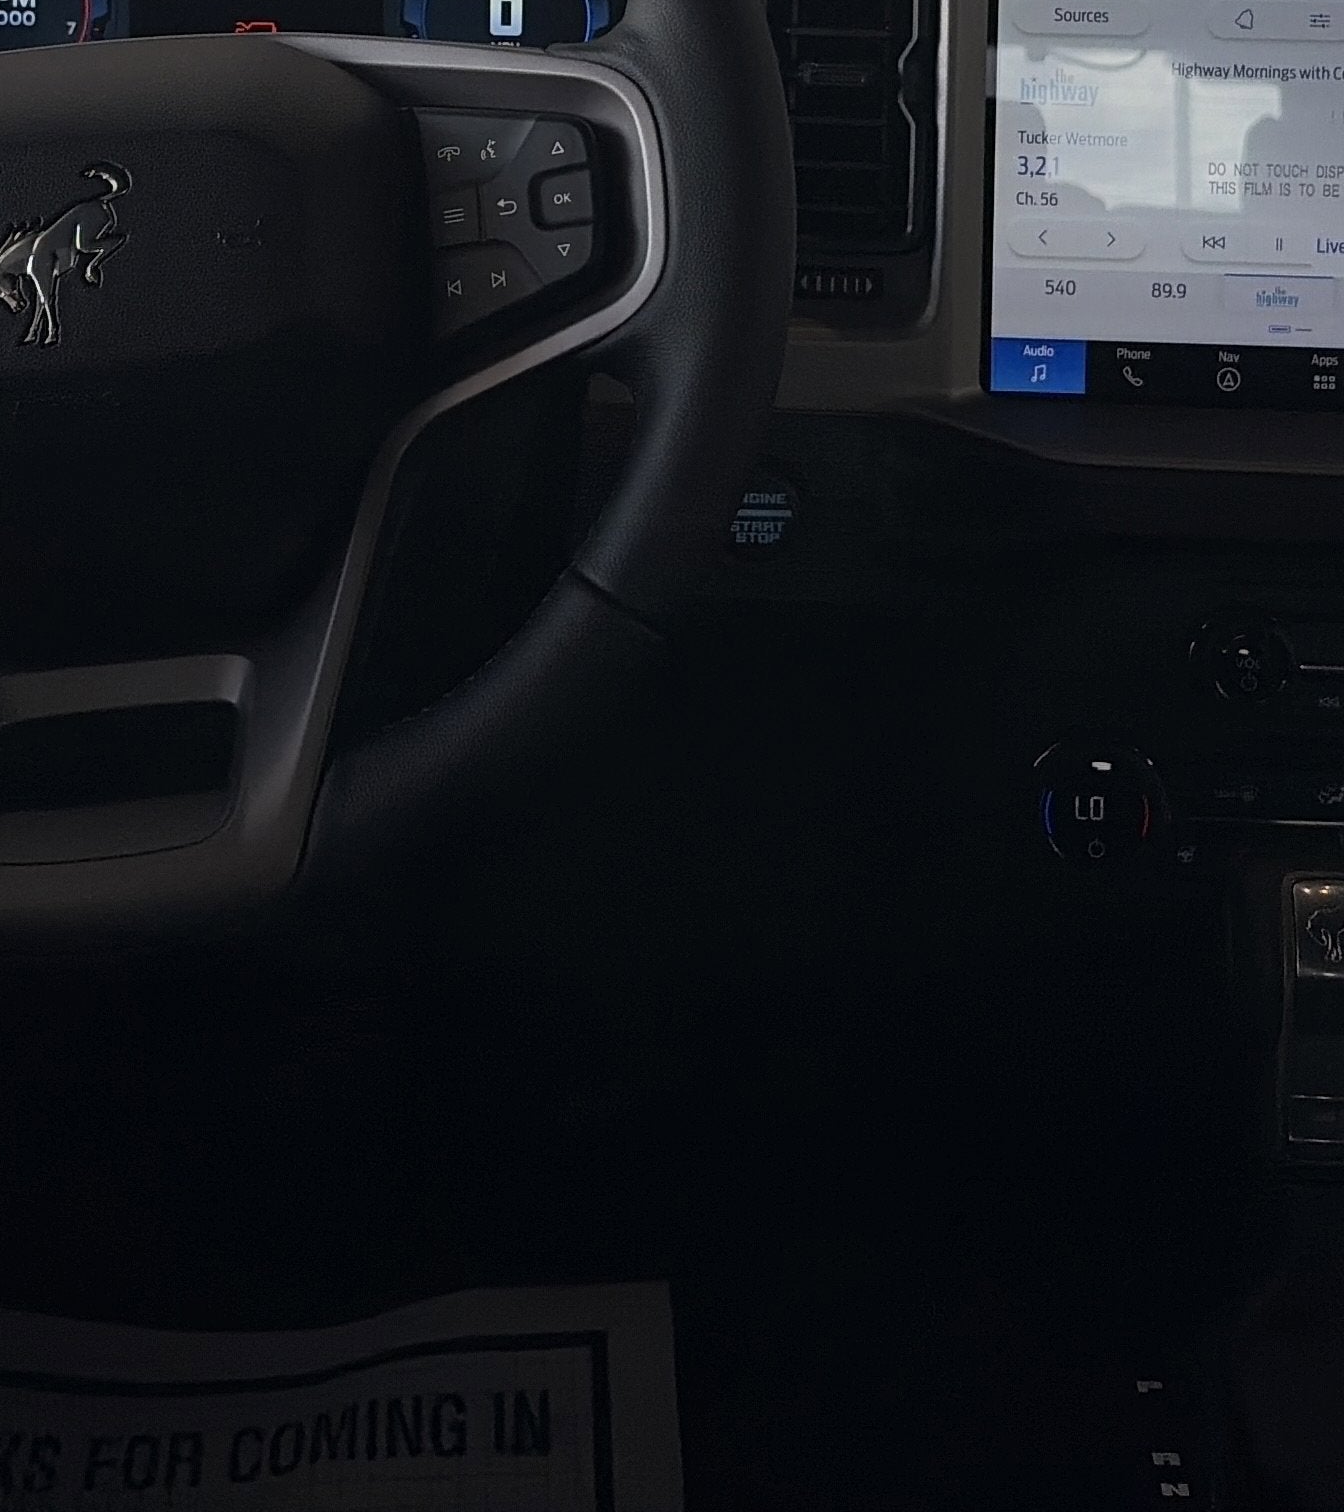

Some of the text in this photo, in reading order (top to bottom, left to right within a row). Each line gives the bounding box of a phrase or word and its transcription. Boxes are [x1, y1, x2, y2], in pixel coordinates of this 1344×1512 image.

[1054, 8, 1109, 24] Sources
[66, 21, 77, 35] 7
[1172, 63, 1231, 80] Highway
[1233, 64, 1297, 81] Mornings
[1299, 66, 1330, 80] with
[1020, 78, 1099, 106] highway
[1017, 130, 1128, 147] Tucker Wetmore
[1208, 162, 1226, 176] DO
[1234, 163, 1260, 177] NOT
[1266, 164, 1307, 178] TOUCH
[1208, 181, 1236, 195] THIS
[1243, 182, 1272, 196] FILM
[1279, 183, 1291, 196] IS
[1298, 183, 1315, 197] TO
[1322, 184, 1340, 198] BE
[554, 193, 571, 205] OK
[1016, 191, 1059, 206] Ch. 56
[1045, 280, 1077, 296] 540
[1151, 283, 1187, 299] 89.9
[1256, 291, 1299, 308] highway
[1023, 345, 1054, 357] Audio
[1116, 348, 1151, 361] Phone
[1218, 351, 1240, 363] Nav
[1311, 355, 1339, 370] Apps
[735, 533, 781, 544] STOP
[1075, 795, 1104, 821] LO
[81, 1428, 206, 1490] FOR
[226, 1393, 468, 1484] COMING
[491, 1386, 553, 1458] IN
[1160, 1483, 1190, 1497] N
